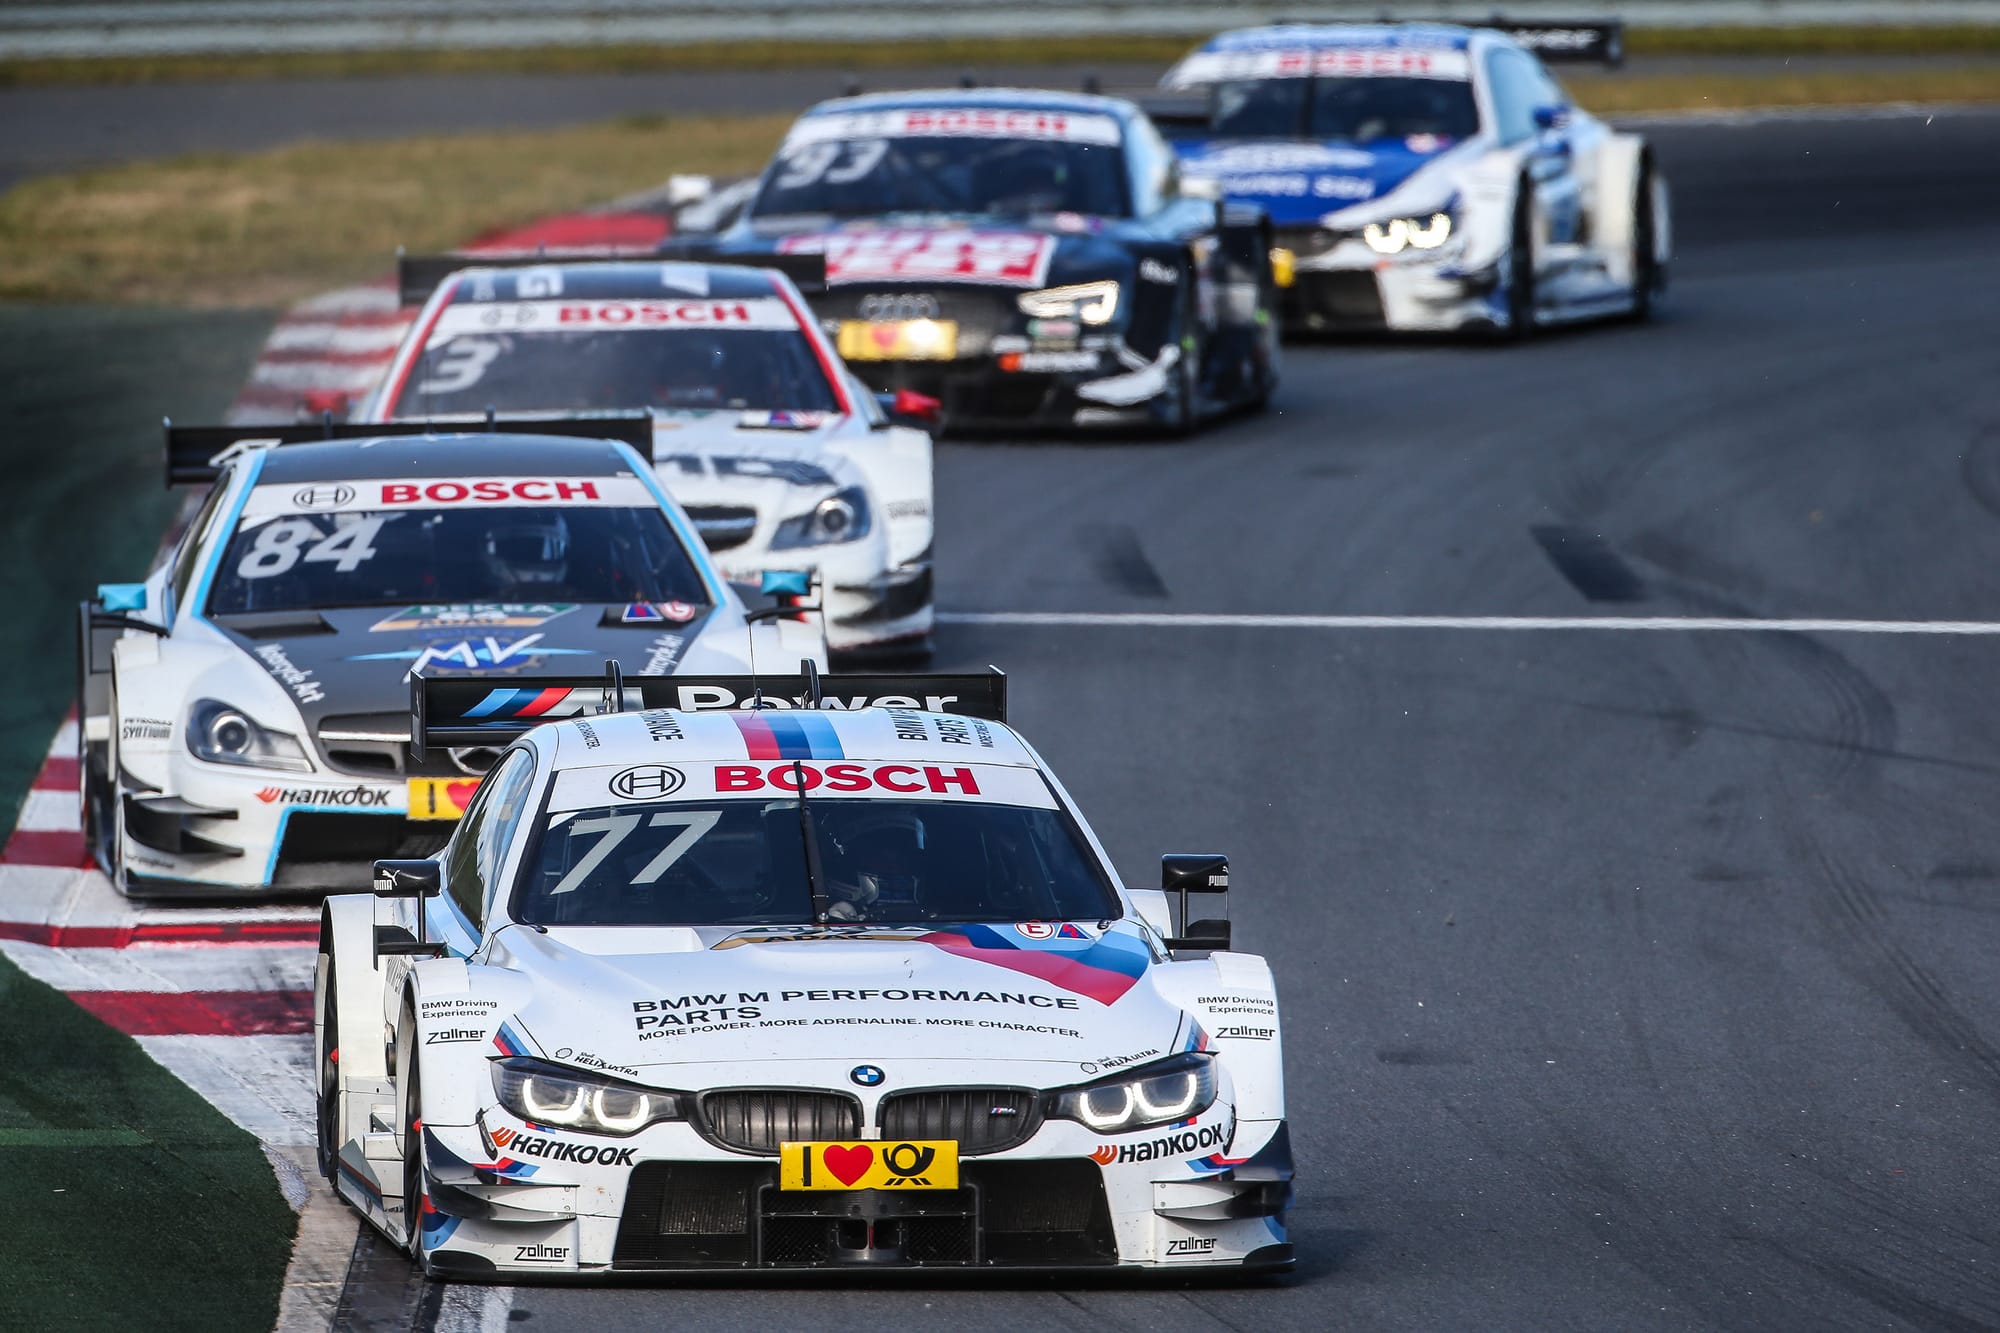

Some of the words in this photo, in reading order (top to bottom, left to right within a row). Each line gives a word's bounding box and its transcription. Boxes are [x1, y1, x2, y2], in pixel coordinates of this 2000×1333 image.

[560, 303, 749, 323] BOSCH
[418, 337, 501, 395] 3
[381, 481, 601, 504] BOSCH
[237, 516, 387, 579] 84
[715, 765, 982, 796] BOSCH
[549, 810, 723, 895] 77
[421, 1000, 453, 1010] BMW
[456, 999, 498, 1009] Driving
[633, 993, 728, 1012] BMW
[738, 992, 770, 1004] M
[781, 989, 1080, 1010] PERFORMANCE
[1198, 996, 1230, 1004] BMW
[1232, 996, 1274, 1007] Driving
[1209, 1006, 1275, 1016] Experience
[422, 1009, 488, 1019] Experience
[635, 1006, 762, 1030] PARTS
[638, 1027, 688, 1042] MORE
[691, 1021, 756, 1035] POWER.
[760, 1018, 808, 1028] MORE
[812, 1017, 922, 1026] ADRENALINE.
[926, 1018, 974, 1027] MORE
[978, 1020, 1085, 1040] CHARACTER.
[1131, 1047, 1161, 1061] ULTRA
[606, 1063, 639, 1077] ULTRA
[803, 1146, 812, 1187] I
